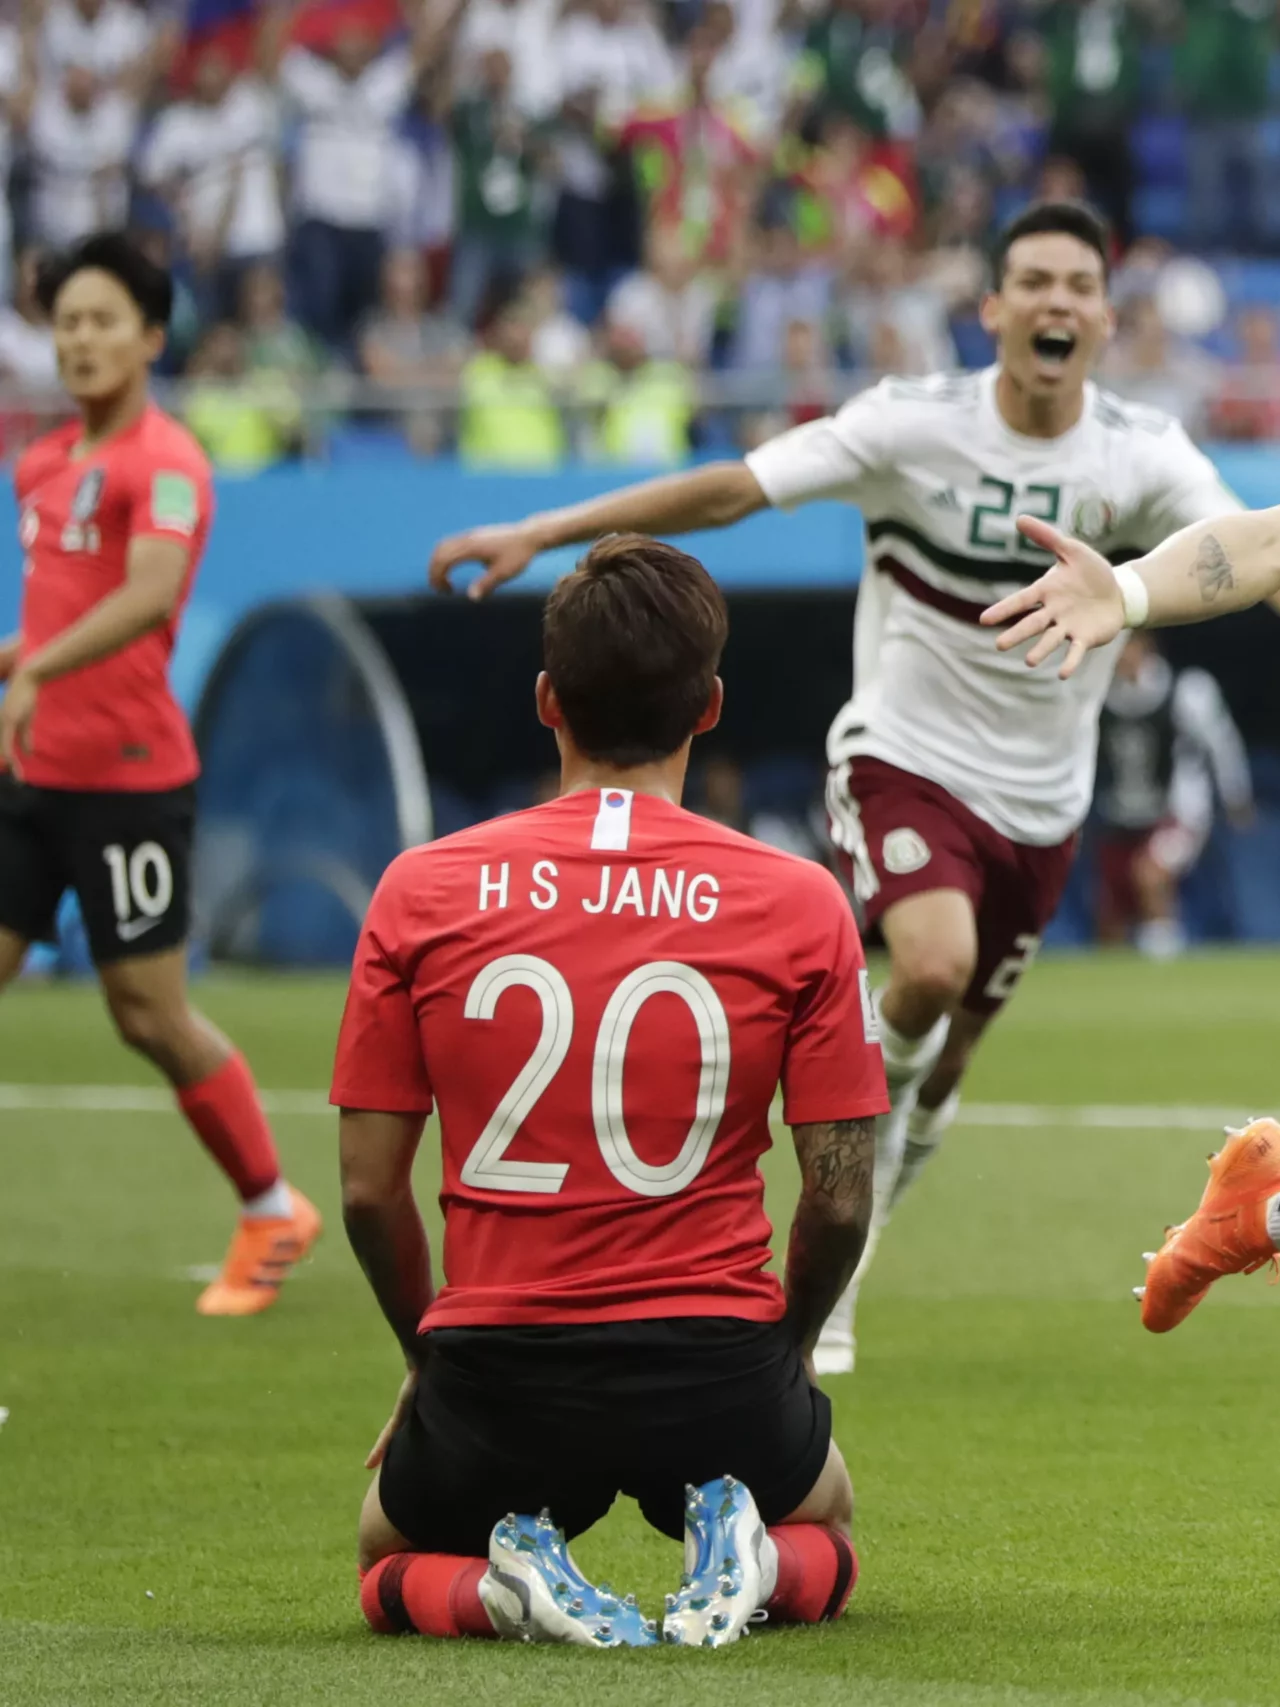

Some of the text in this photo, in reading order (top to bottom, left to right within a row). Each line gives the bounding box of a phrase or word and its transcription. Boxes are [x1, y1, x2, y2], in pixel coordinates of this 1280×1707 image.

[102, 841, 173, 921] 10
[479, 860, 720, 922] H S JANG
[460, 953, 731, 1197] 20
